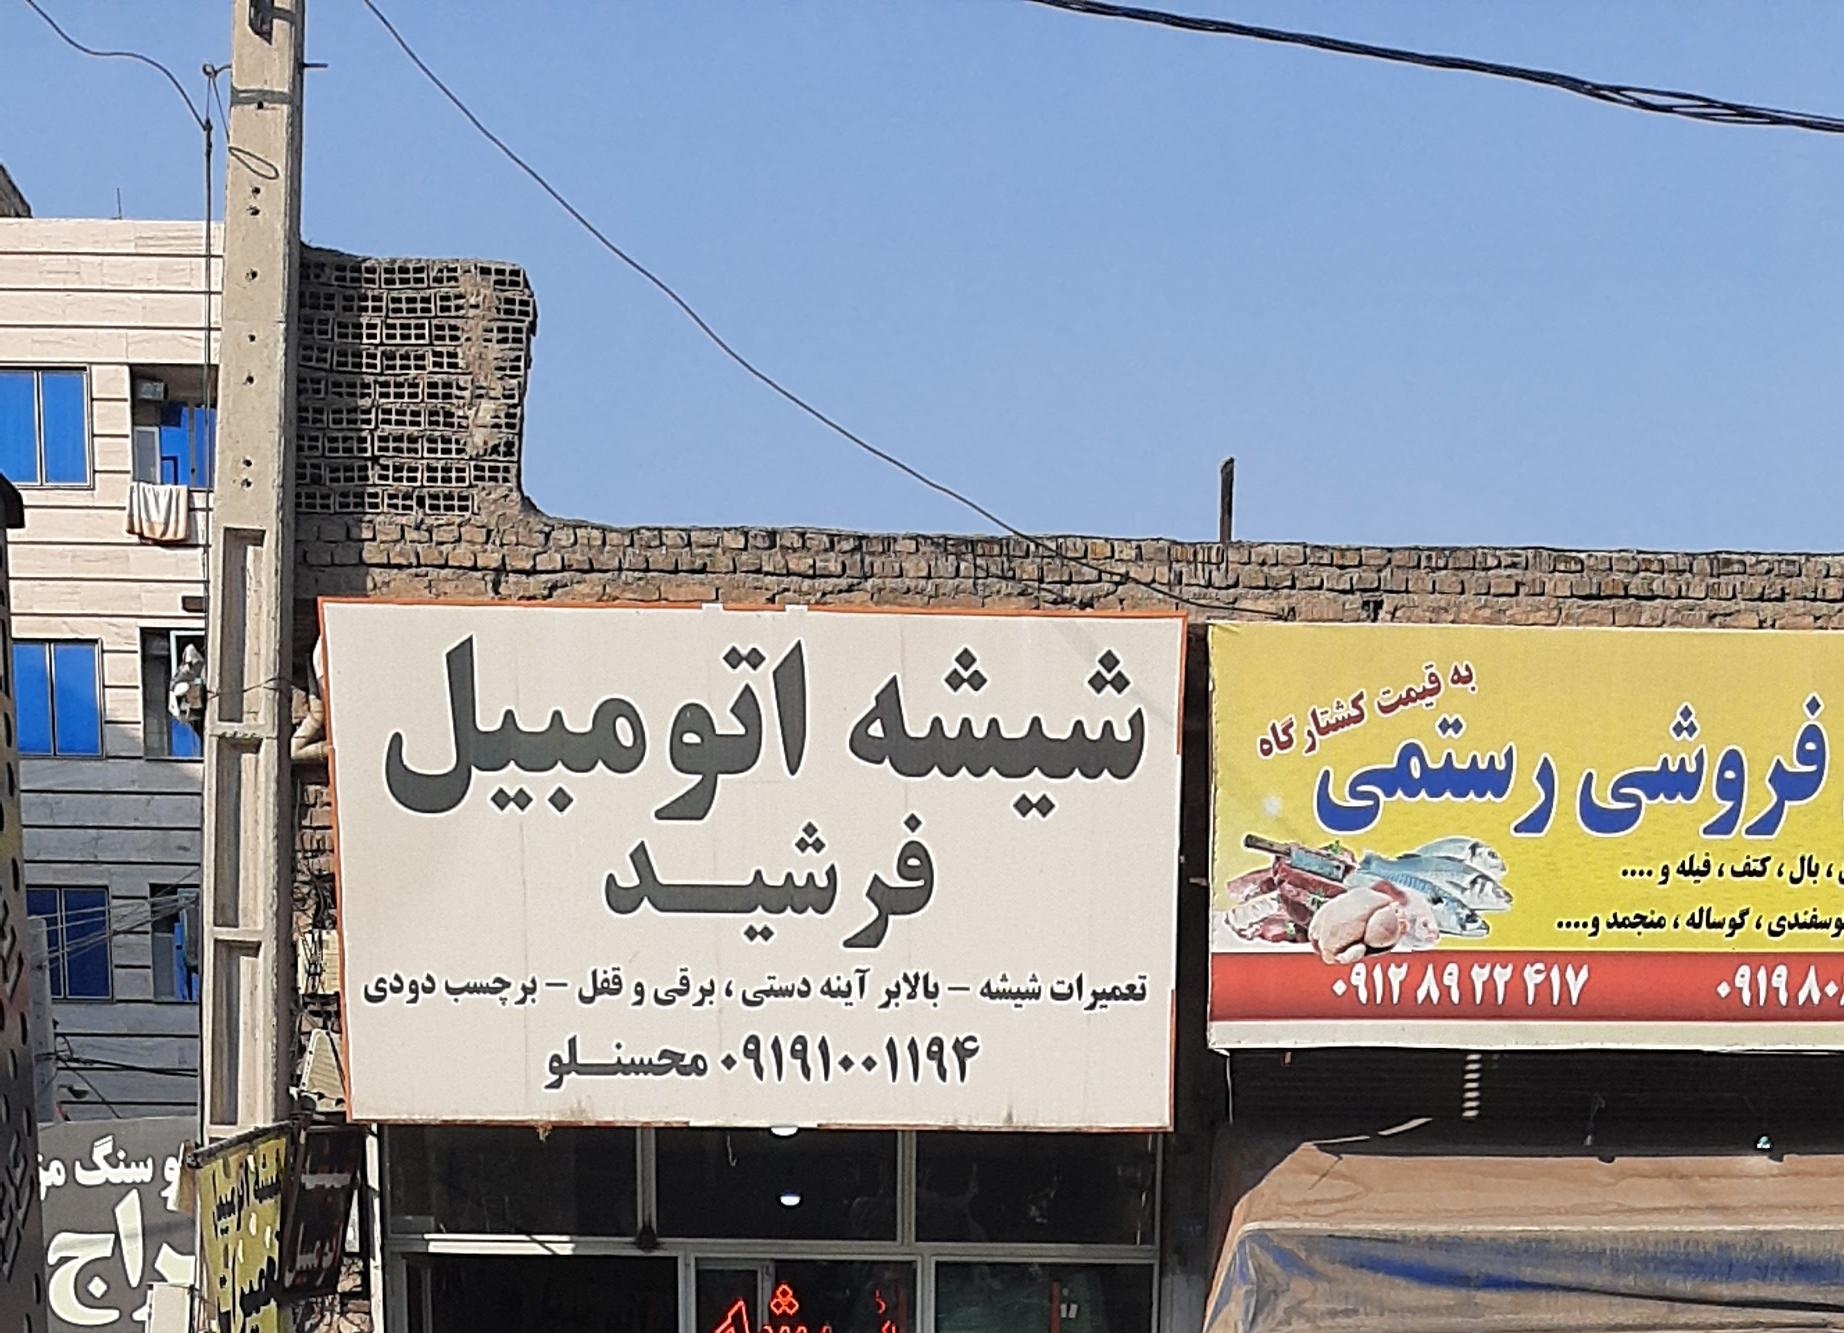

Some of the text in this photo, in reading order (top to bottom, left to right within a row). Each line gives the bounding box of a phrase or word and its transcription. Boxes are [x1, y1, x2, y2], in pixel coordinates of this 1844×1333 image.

[1378, 664, 1441, 714] قیمت
[1450, 664, 1476, 692] به
[386, 635, 1144, 819] شیشه اتومبیل
[1316, 696, 1827, 836] فروشی رستمی
[605, 813, 935, 947] فرشید
[1658, 863, 1670, 885] و
[1676, 852, 1711, 884] فیله
[1731, 853, 1771, 878] کتف
[1790, 854, 1820, 885] بال
[1605, 910, 1666, 935] منجمد
[1686, 906, 1750, 937] گوساله
[1767, 907, 1844, 938] وسفندی
[364, 971, 436, 1004] دودی
[444, 973, 537, 1007] برچسب
[577, 966, 623, 1005] قفل
[631, 983, 645, 1007] و
[653, 966, 716, 1007] برقی
[741, 974, 811, 1007] دستی
[820, 967, 871, 1007] آینه
[878, 971, 940, 1009] بالابر
[979, 972, 1041, 1009] شیشه
[1049, 972, 1147, 1011] تعمیرات
[1331, 962, 1589, 1006] ۰۹۱۲ ۸۹ ۲۲ ۴۱۷
[1716, 963, 1844, 1008] ۰۹۱۹ ۸۰
[720, 1032, 980, 1084] ۰۹۱۹۱۰۰۱۱۹۴
[75, 1134, 153, 1187] سنگ
